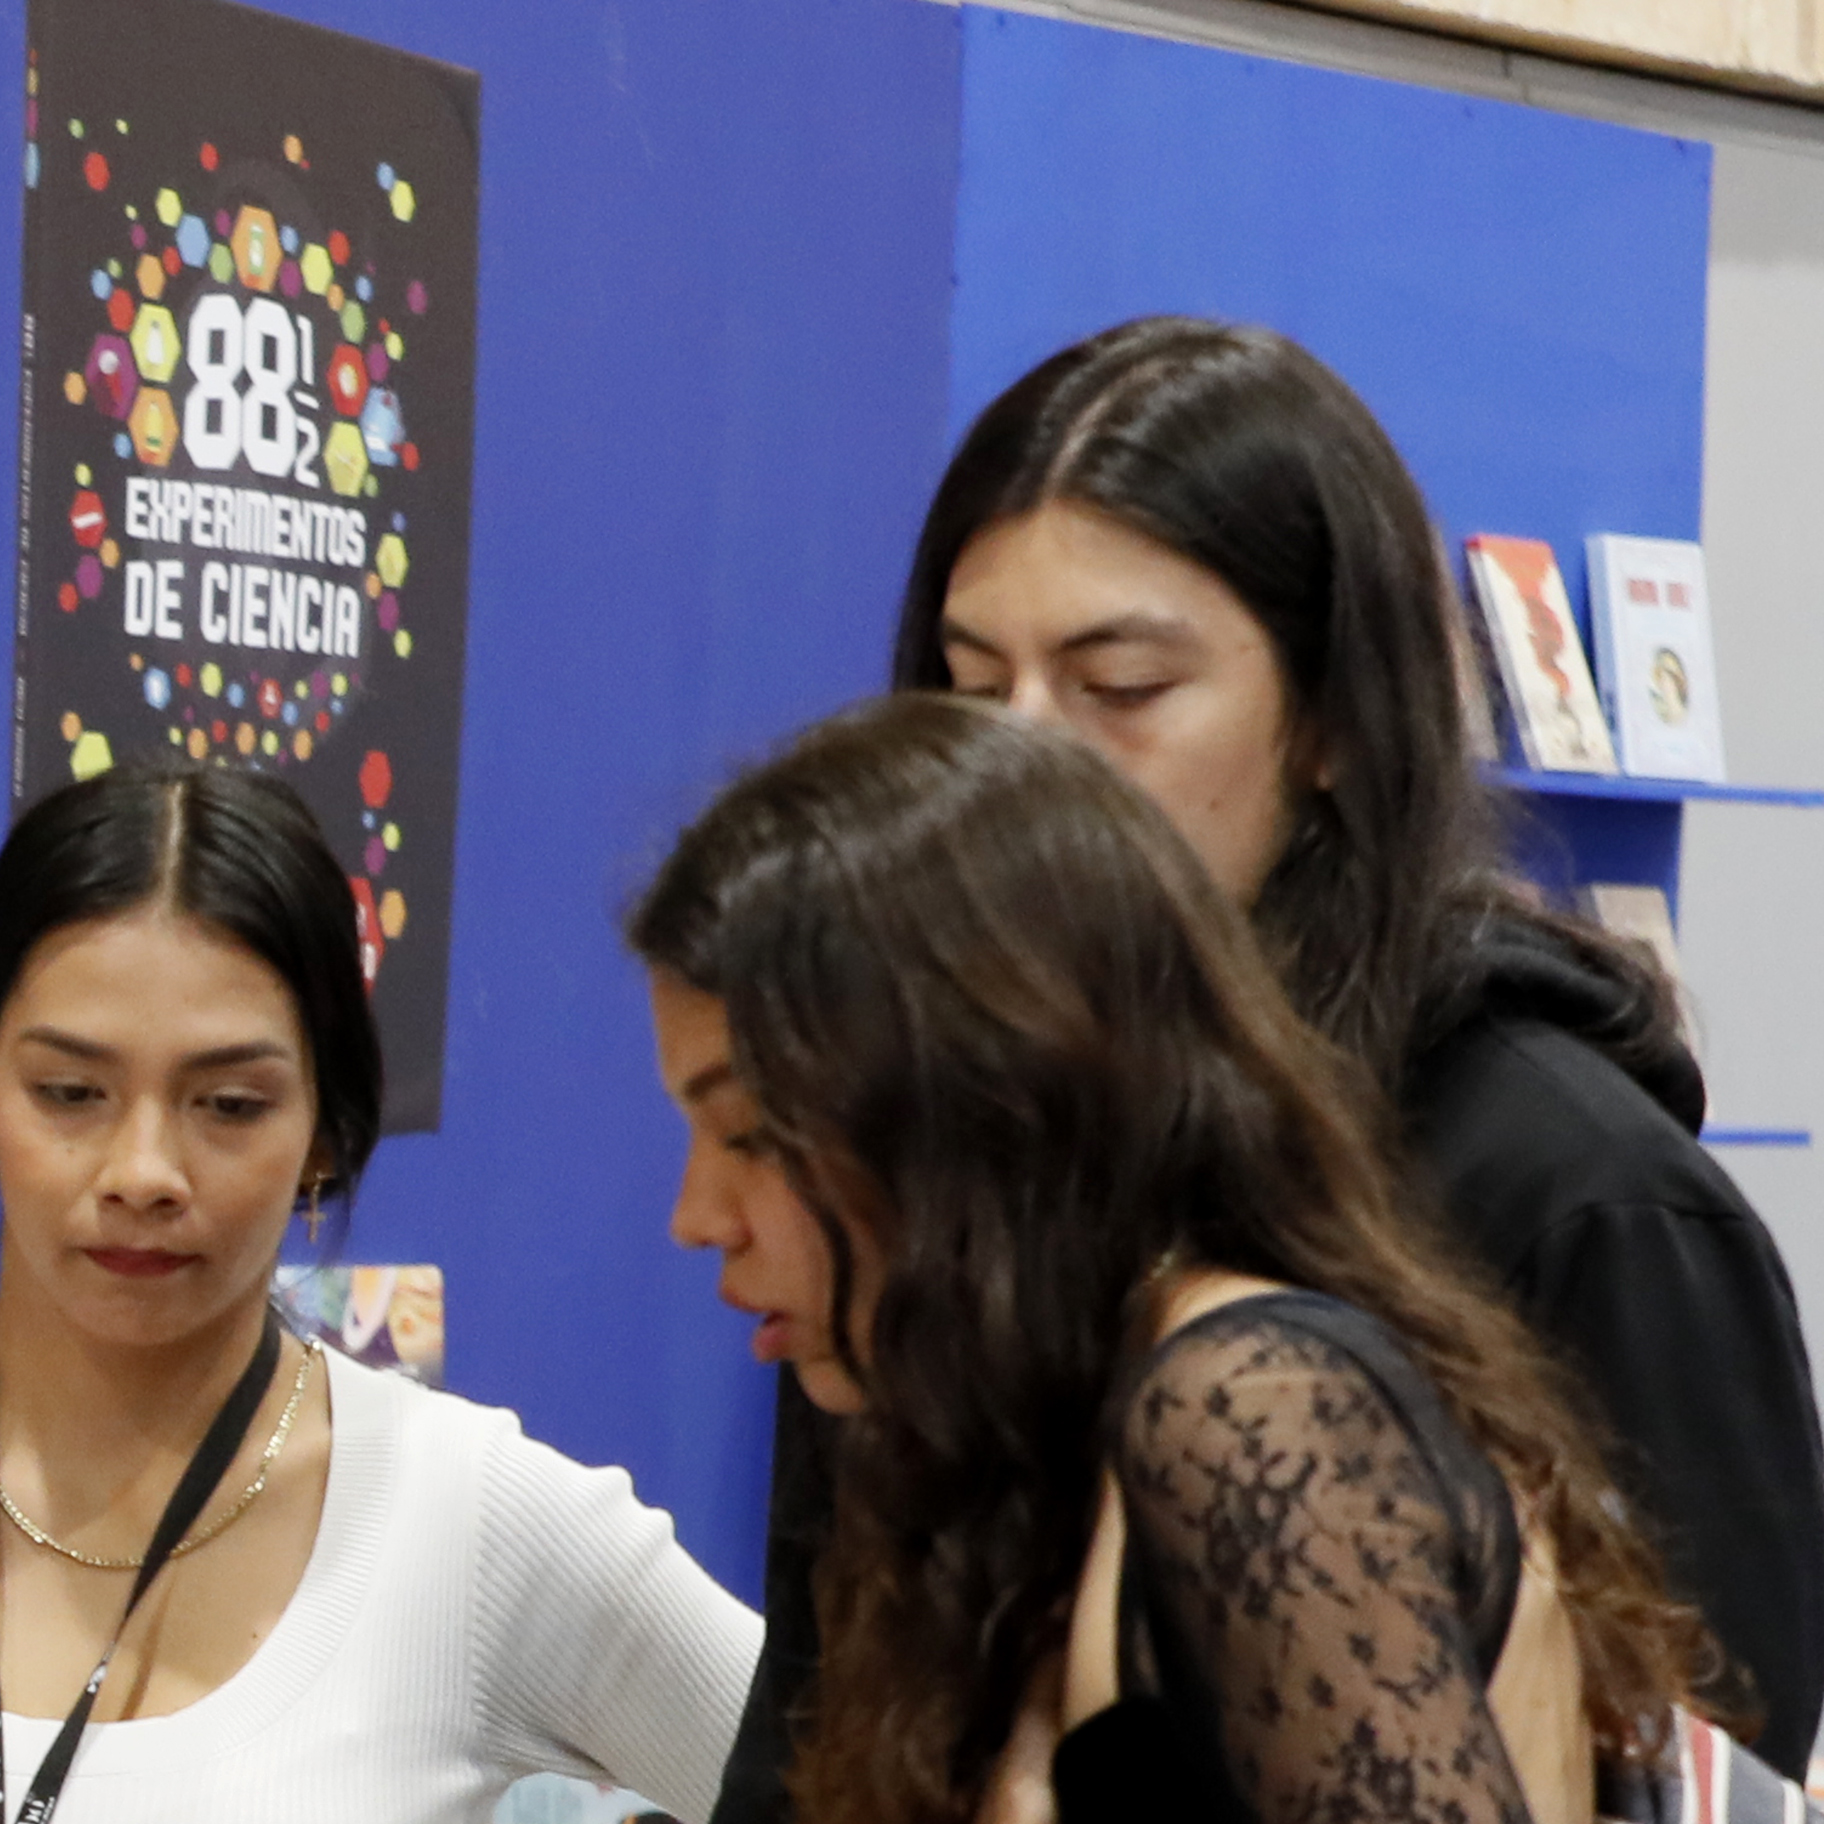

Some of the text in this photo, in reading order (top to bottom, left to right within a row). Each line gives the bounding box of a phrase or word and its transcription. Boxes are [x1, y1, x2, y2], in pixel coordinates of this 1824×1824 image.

[124, 477, 368, 568] EXPERIMENTOS
[123, 560, 360, 659] DE CIENCIA
